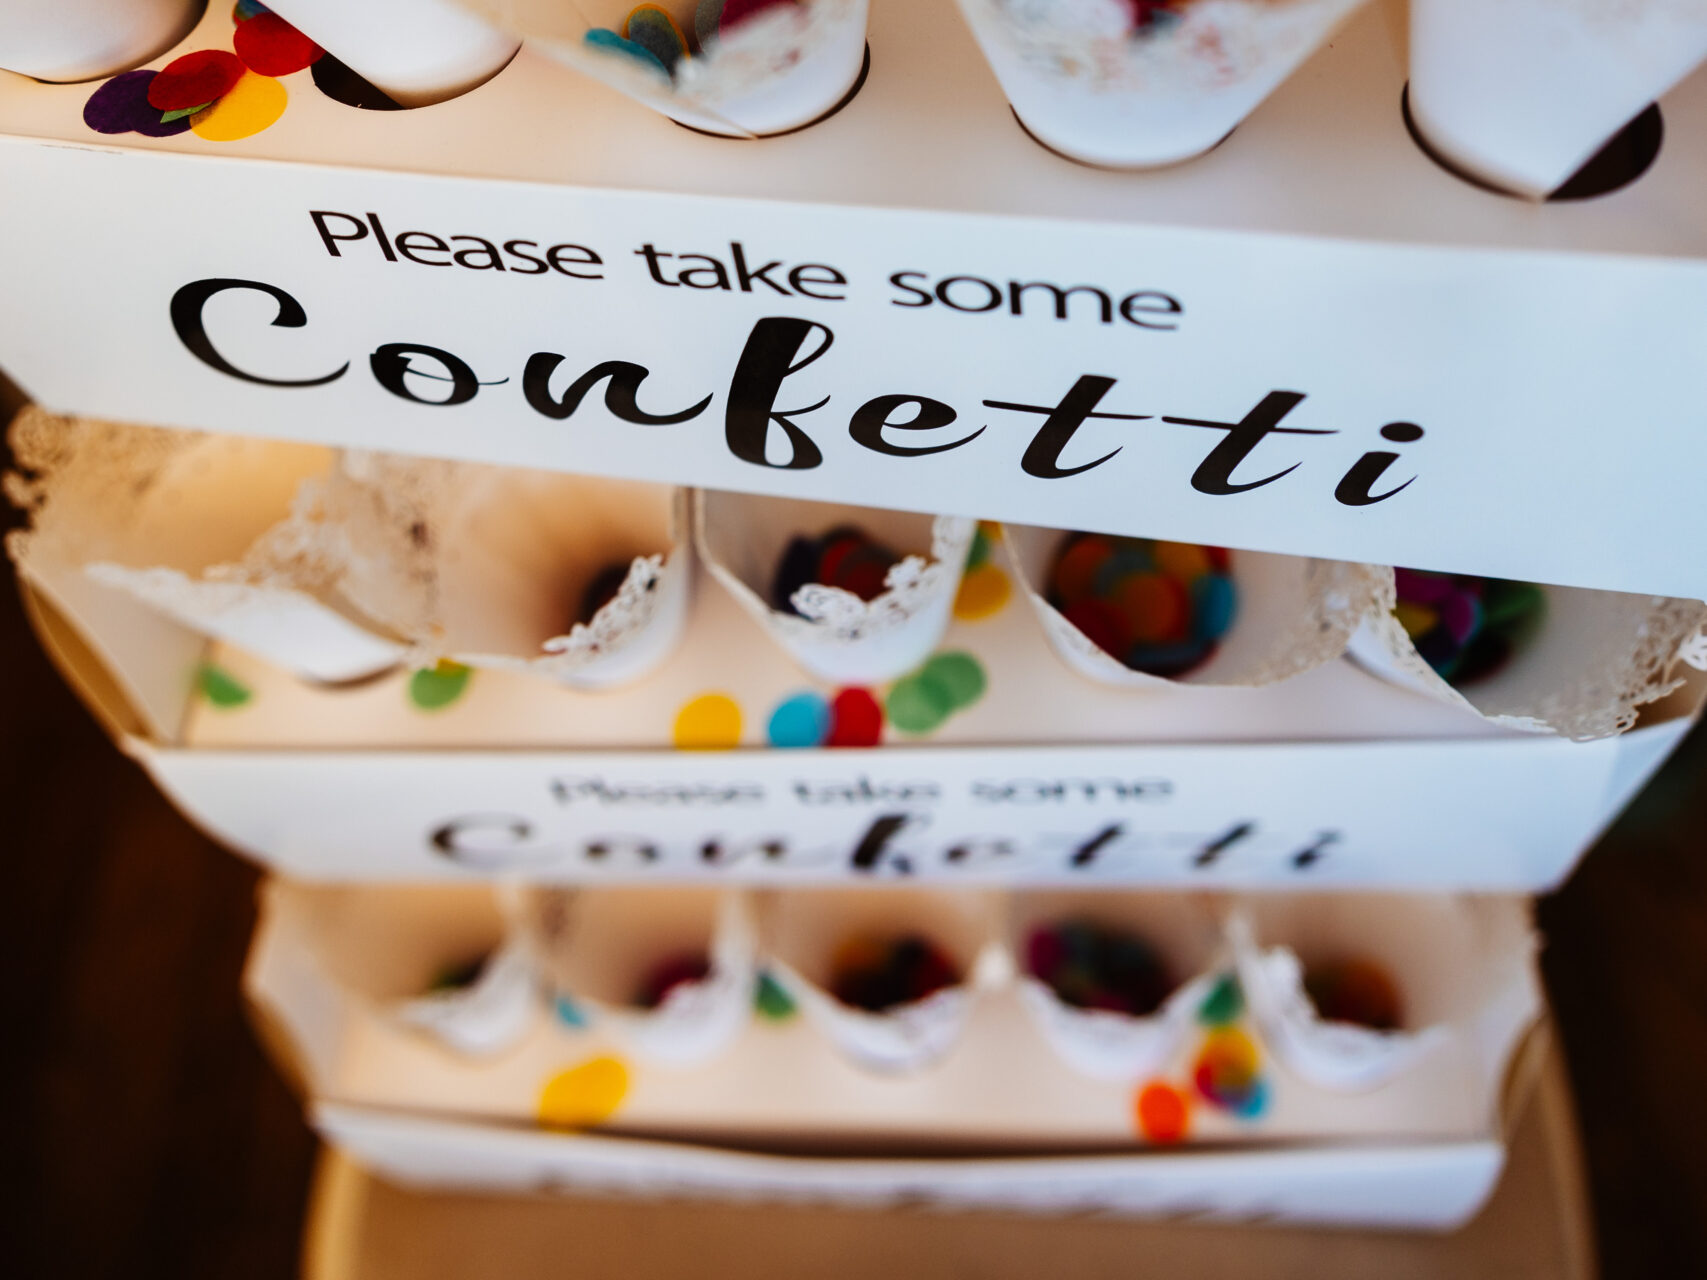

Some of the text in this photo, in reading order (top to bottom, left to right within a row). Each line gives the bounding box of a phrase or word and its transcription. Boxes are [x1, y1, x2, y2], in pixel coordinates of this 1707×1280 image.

[309, 209, 1182, 329] Please take some
[169, 276, 1426, 508] Confetti
[549, 774, 1175, 808] Please take some
